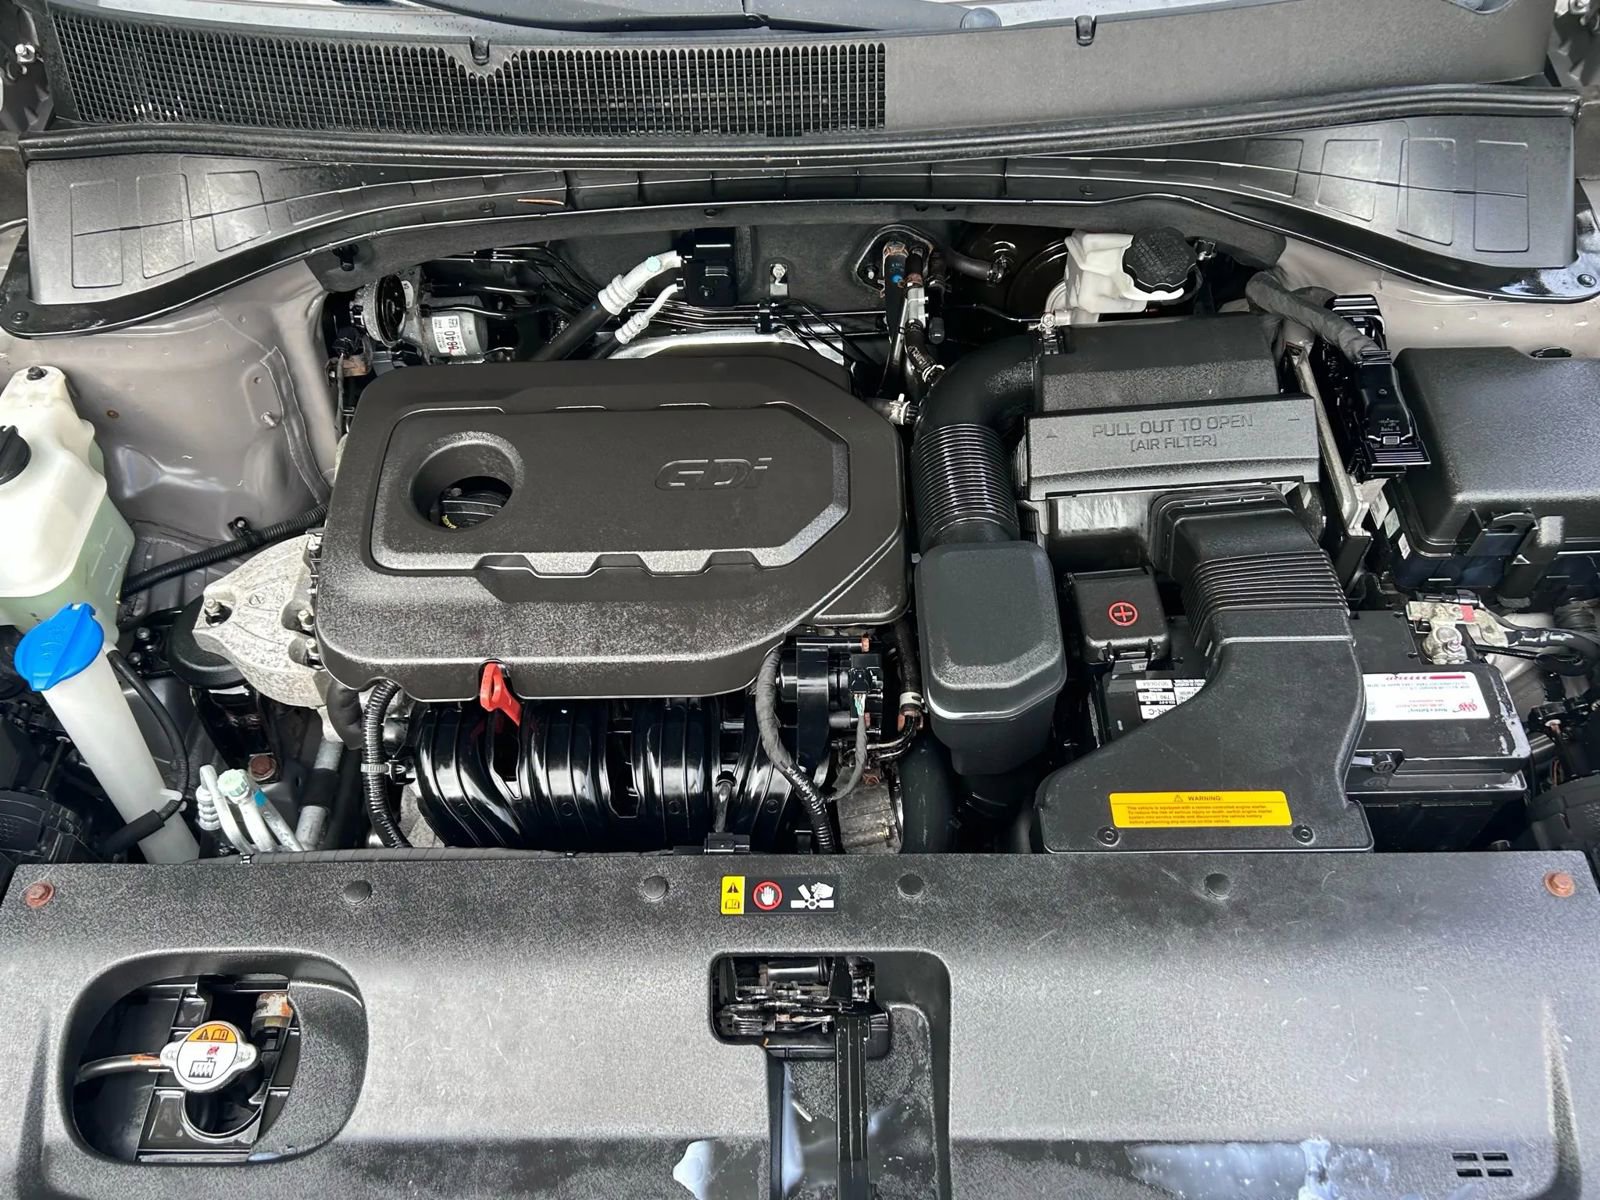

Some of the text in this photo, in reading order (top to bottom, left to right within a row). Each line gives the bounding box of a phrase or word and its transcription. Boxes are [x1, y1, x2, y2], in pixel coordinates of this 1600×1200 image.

[1092, 415, 1253, 437] PULL OUT TO OPEN
